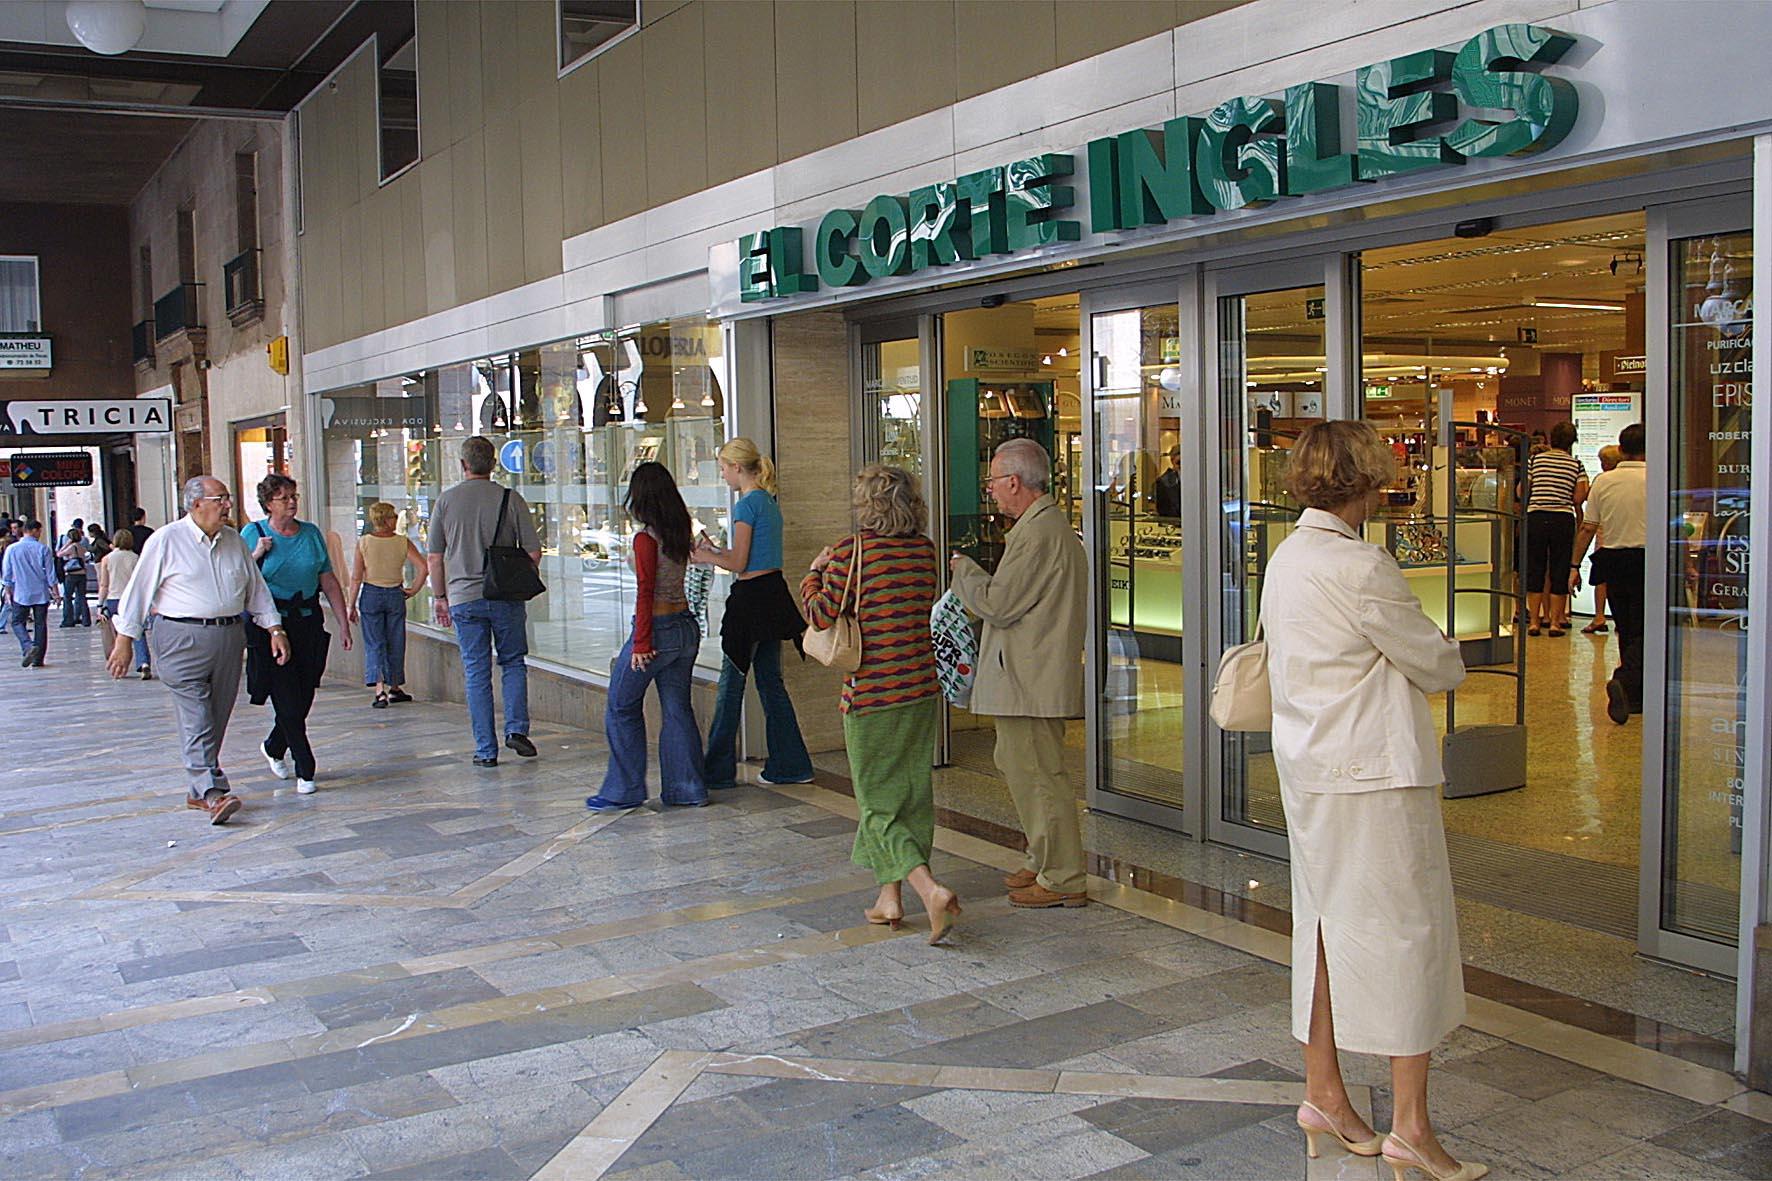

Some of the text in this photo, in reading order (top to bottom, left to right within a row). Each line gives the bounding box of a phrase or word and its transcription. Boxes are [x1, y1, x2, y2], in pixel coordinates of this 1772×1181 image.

[739, 23, 1578, 303] EL CORTE INGLES
[1707, 339, 1753, 350] PURIFICA
[38, 407, 163, 426] TRICIA
[1718, 465, 1751, 474] BUR
